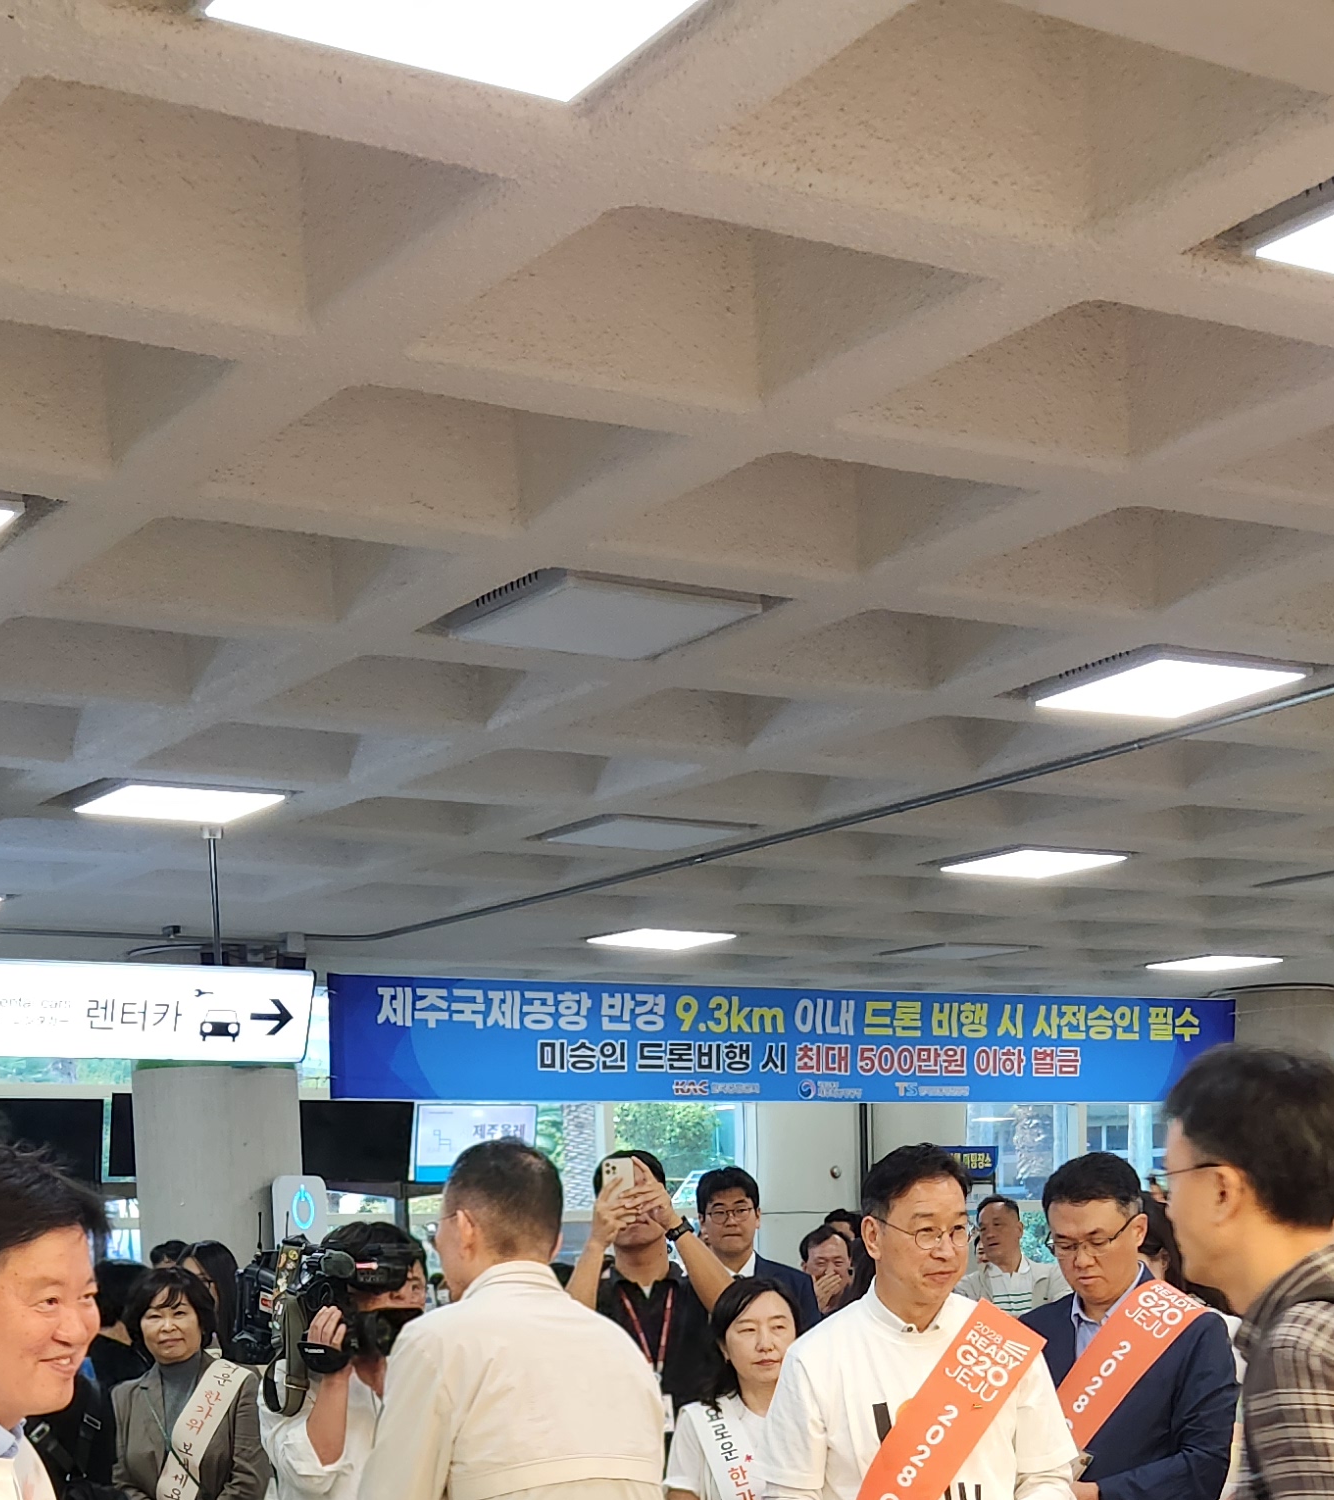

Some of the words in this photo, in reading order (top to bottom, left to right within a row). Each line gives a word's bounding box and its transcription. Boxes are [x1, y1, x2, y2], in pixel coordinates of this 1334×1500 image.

[86, 998, 183, 1032] 렌터카
[375, 985, 589, 1031] 제주국제공항
[600, 992, 666, 1032] 반경
[675, 995, 785, 1034] 9.3km
[793, 997, 855, 1036] 이내
[863, 1000, 923, 1037] 드론
[931, 1001, 989, 1039] 비행
[996, 1003, 1025, 1040] 시
[1032, 1004, 1141, 1041] 사전승인
[1148, 1006, 1201, 1042] 필수
[537, 1038, 628, 1072] 미승인
[635, 1041, 752, 1073] 드론비행
[760, 1043, 787, 1074] 시
[795, 1043, 850, 1075] 최대
[857, 1045, 967, 1077] 500만원
[974, 1046, 1025, 1077] 이하
[1031, 1046, 1081, 1078] 벌금
[1137, 1290, 1184, 1326] G20
[1149, 1283, 1199, 1313] READY
[973, 1320, 1004, 1345] 2028
[1124, 1306, 1172, 1339] JEJU
[955, 1344, 1010, 1388] G20
[965, 1329, 1022, 1371] READY
[944, 1364, 1000, 1403] JEJU
[1072, 1340, 1133, 1414] 2028
[896, 1404, 959, 1488] 2028
